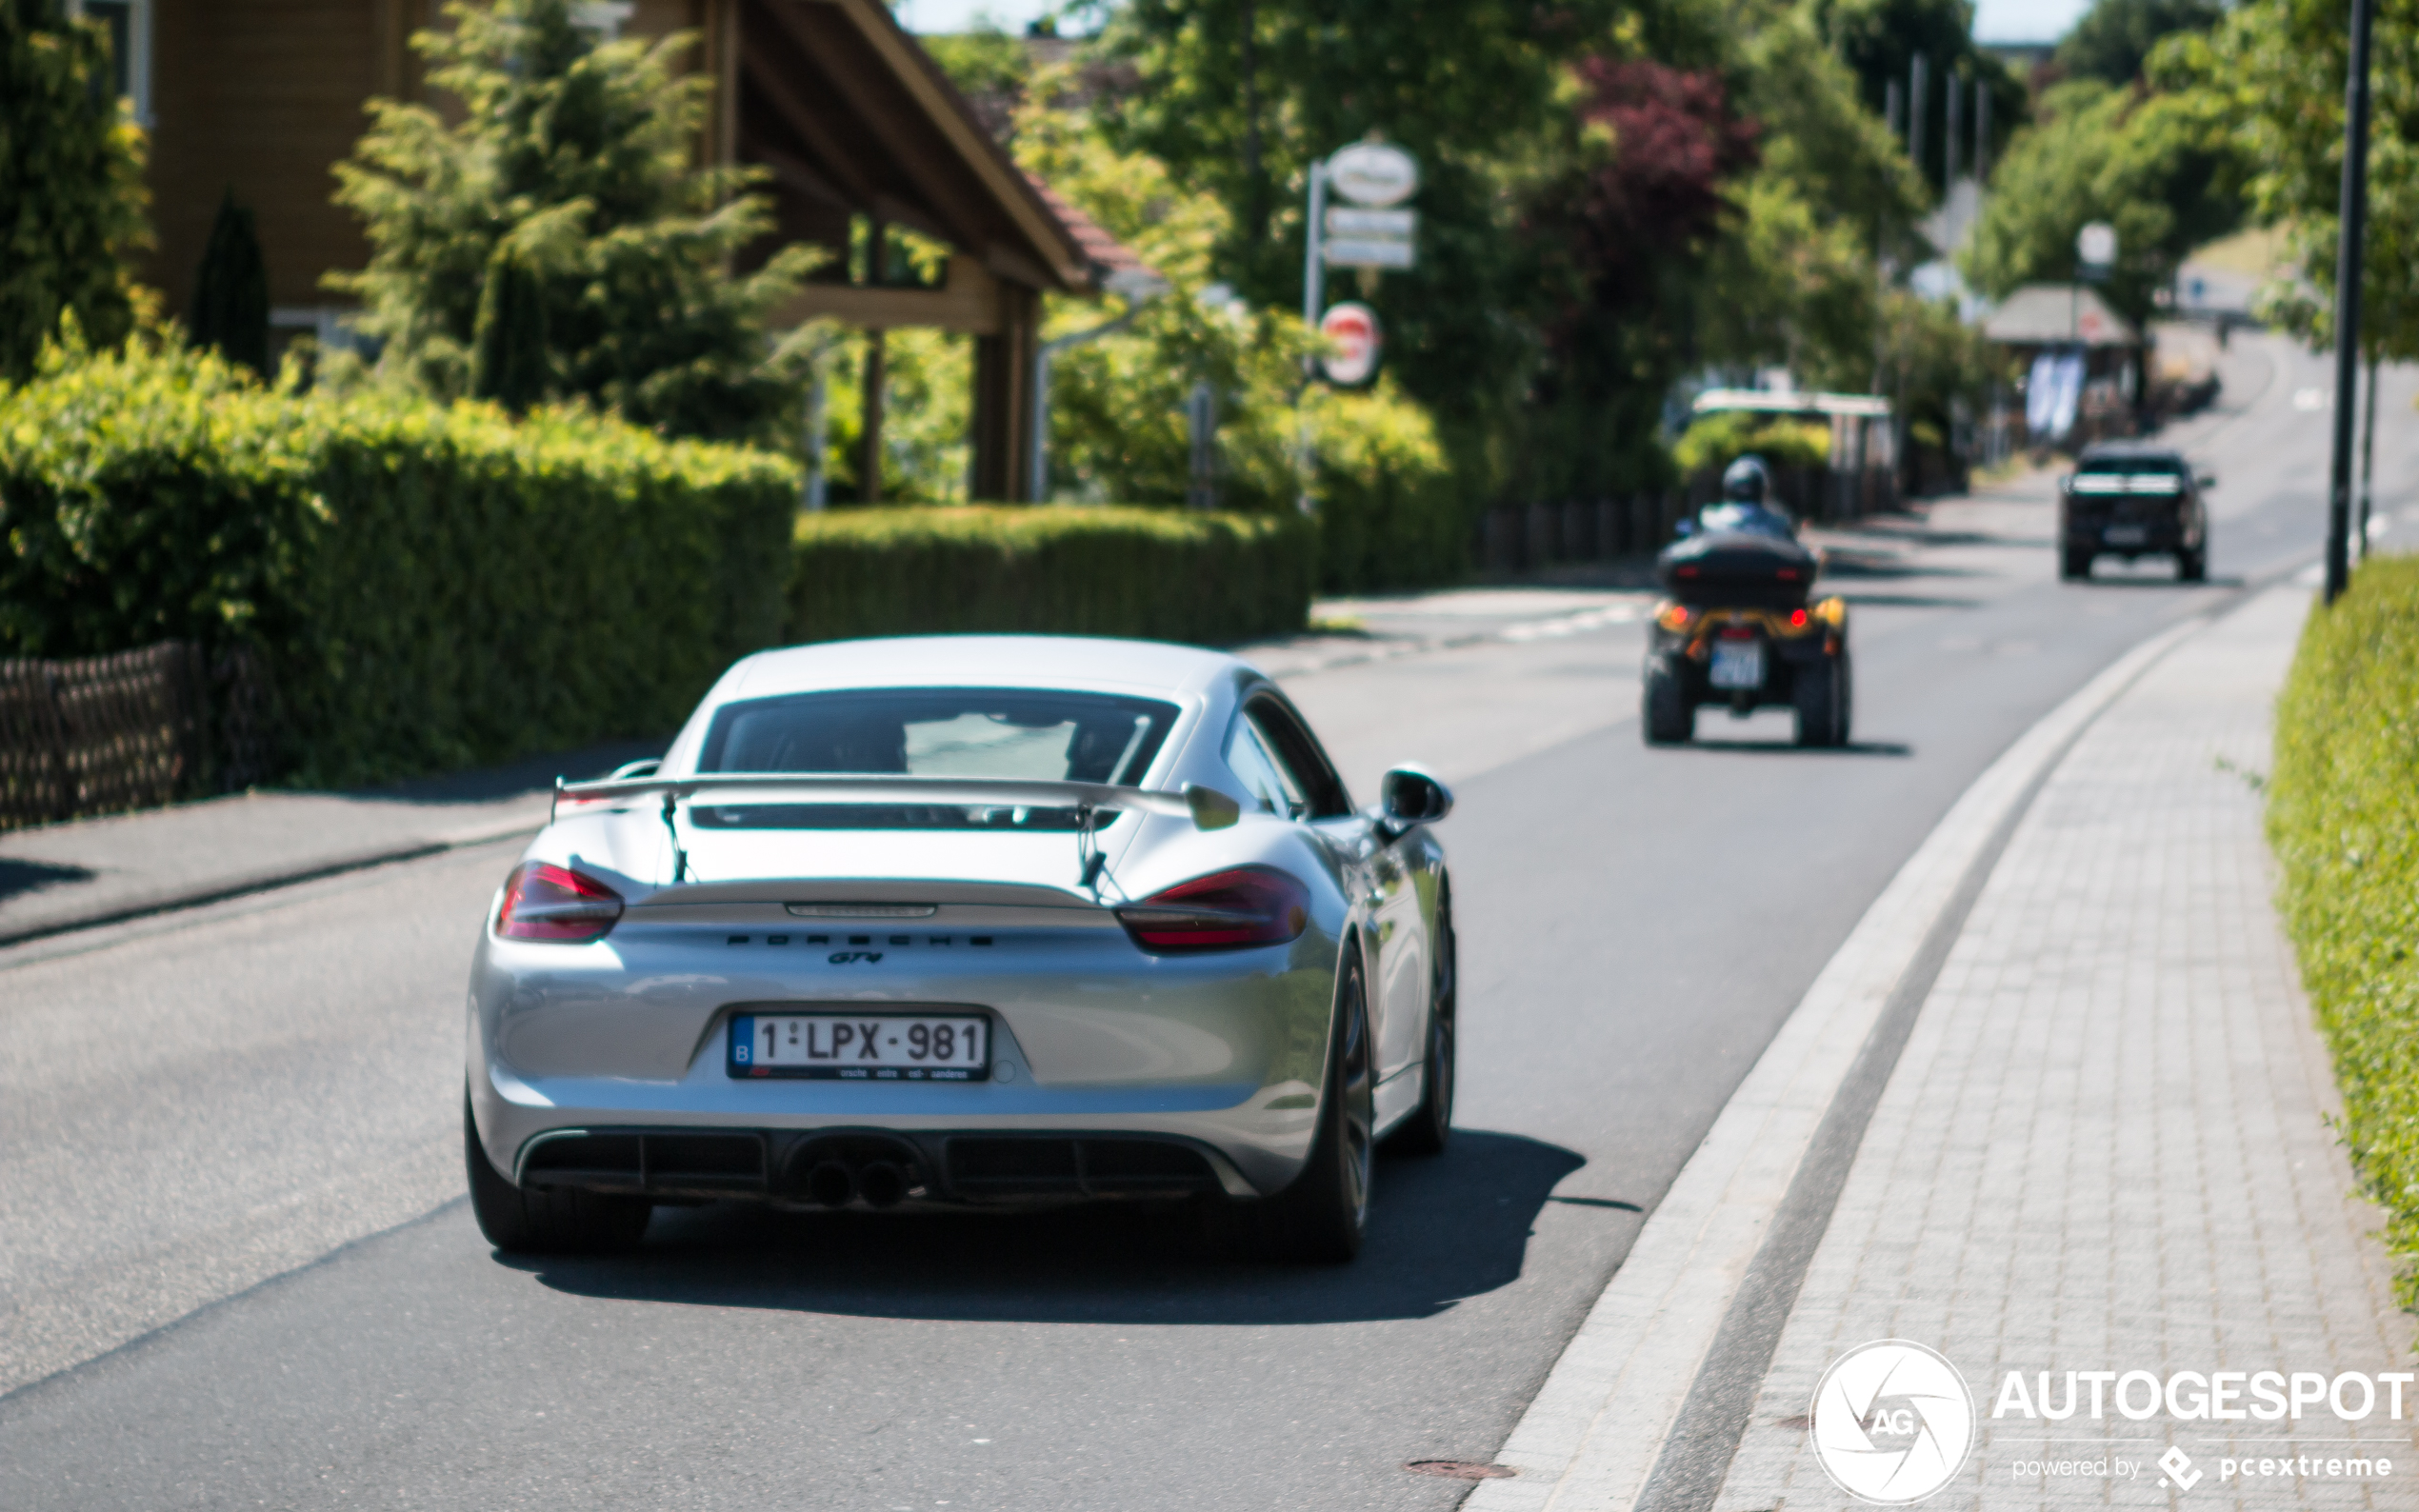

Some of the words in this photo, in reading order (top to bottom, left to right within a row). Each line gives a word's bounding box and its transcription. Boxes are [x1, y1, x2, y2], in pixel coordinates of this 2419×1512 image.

[727, 934, 993, 946] PORSCHE
[827, 951, 884, 965] GT4
[735, 1044, 750, 1062] B
